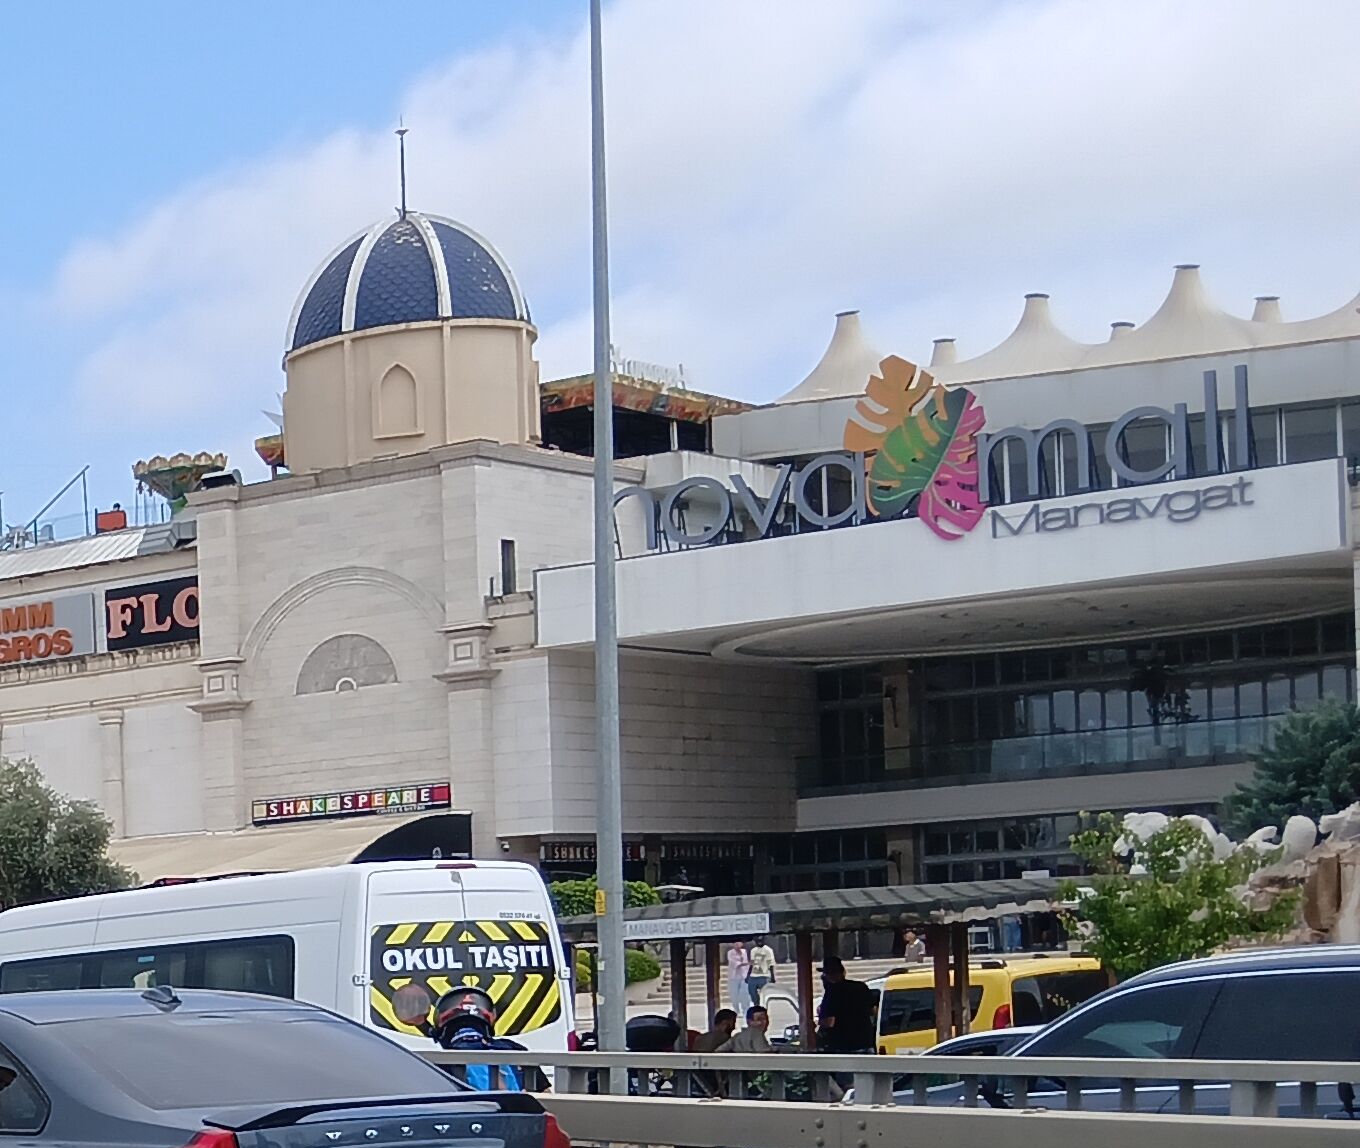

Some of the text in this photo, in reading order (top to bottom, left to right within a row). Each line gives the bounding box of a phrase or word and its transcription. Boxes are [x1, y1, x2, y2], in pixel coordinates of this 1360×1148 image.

[613, 364, 1250, 550] nova mall
[991, 475, 1255, 539] Manavgat
[106, 586, 200, 639] FLO
[269, 788, 431, 816] SHAKESPEARE
[553, 845, 632, 859] SHAKESE
[382, 945, 550, 973] OKUL TAŞITI
[325, 1123, 483, 1140] VOLVO
